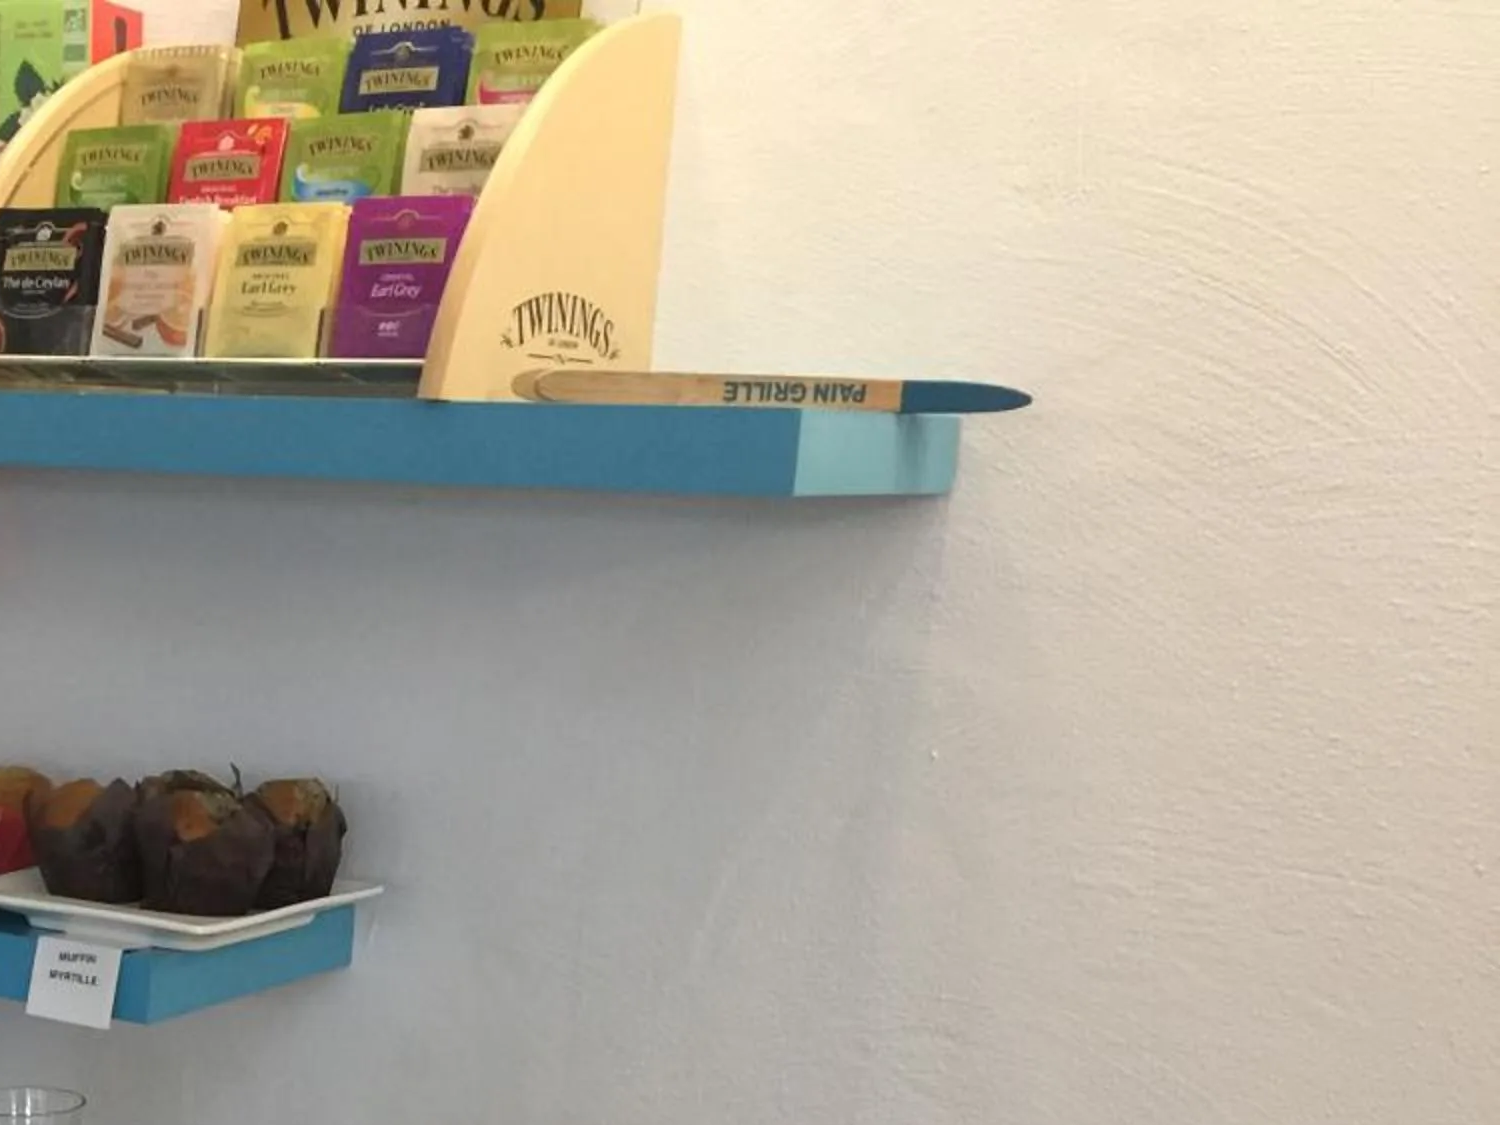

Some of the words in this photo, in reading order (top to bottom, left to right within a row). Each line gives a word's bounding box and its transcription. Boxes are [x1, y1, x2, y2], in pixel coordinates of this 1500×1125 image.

[512, 291, 615, 358] TWININGS
[813, 382, 868, 404] PAIN
[58, 951, 98, 964] MUFFIN
[48, 969, 99, 987] MYRTILLE
